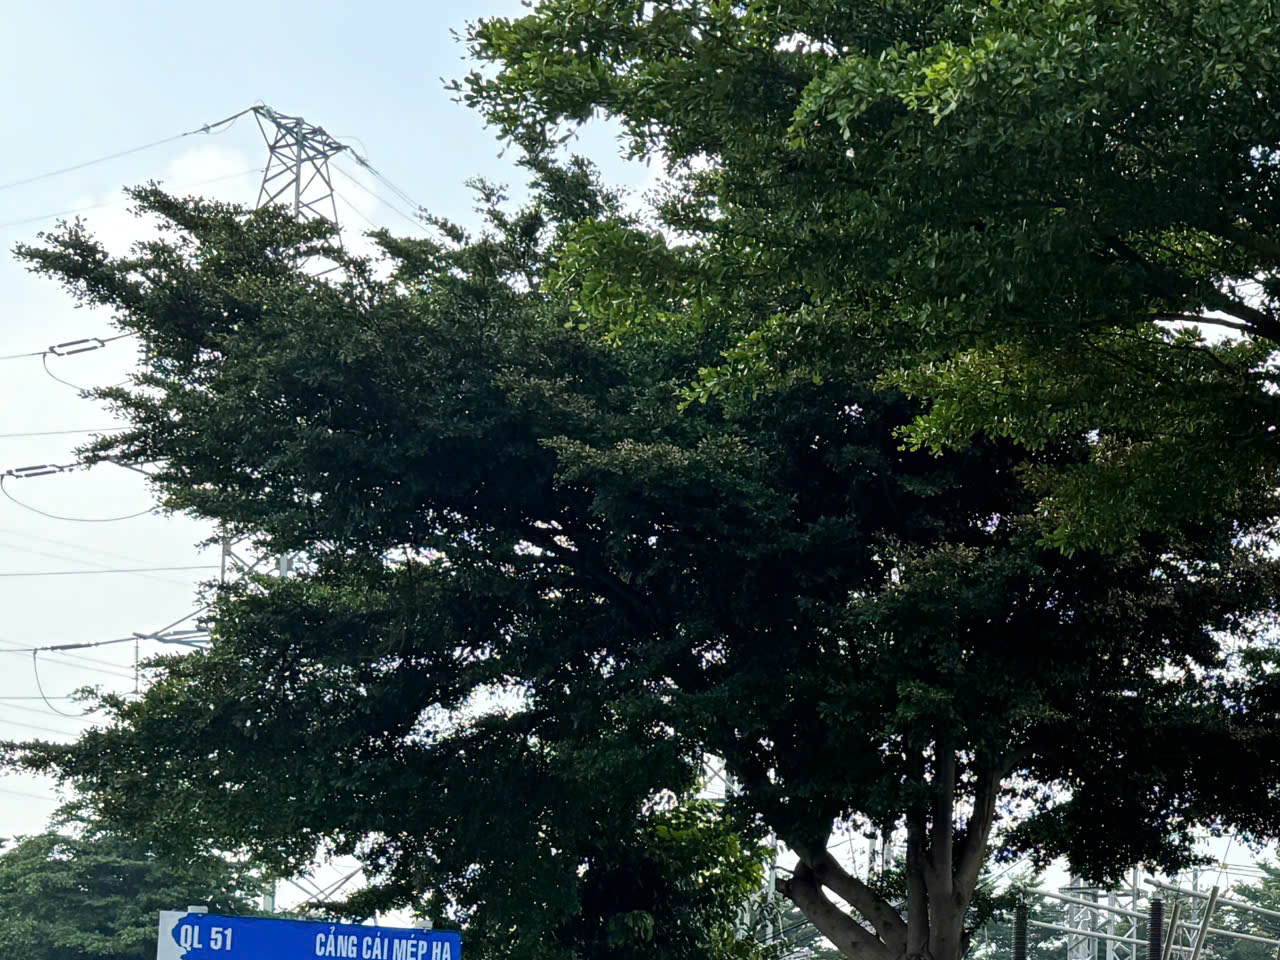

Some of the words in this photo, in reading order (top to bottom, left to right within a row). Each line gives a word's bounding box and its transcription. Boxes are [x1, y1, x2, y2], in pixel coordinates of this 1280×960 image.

[180, 924, 203, 951] QL
[210, 926, 232, 951] 51
[315, 926, 358, 958] CẢNG
[362, 931, 389, 960] CÁI
